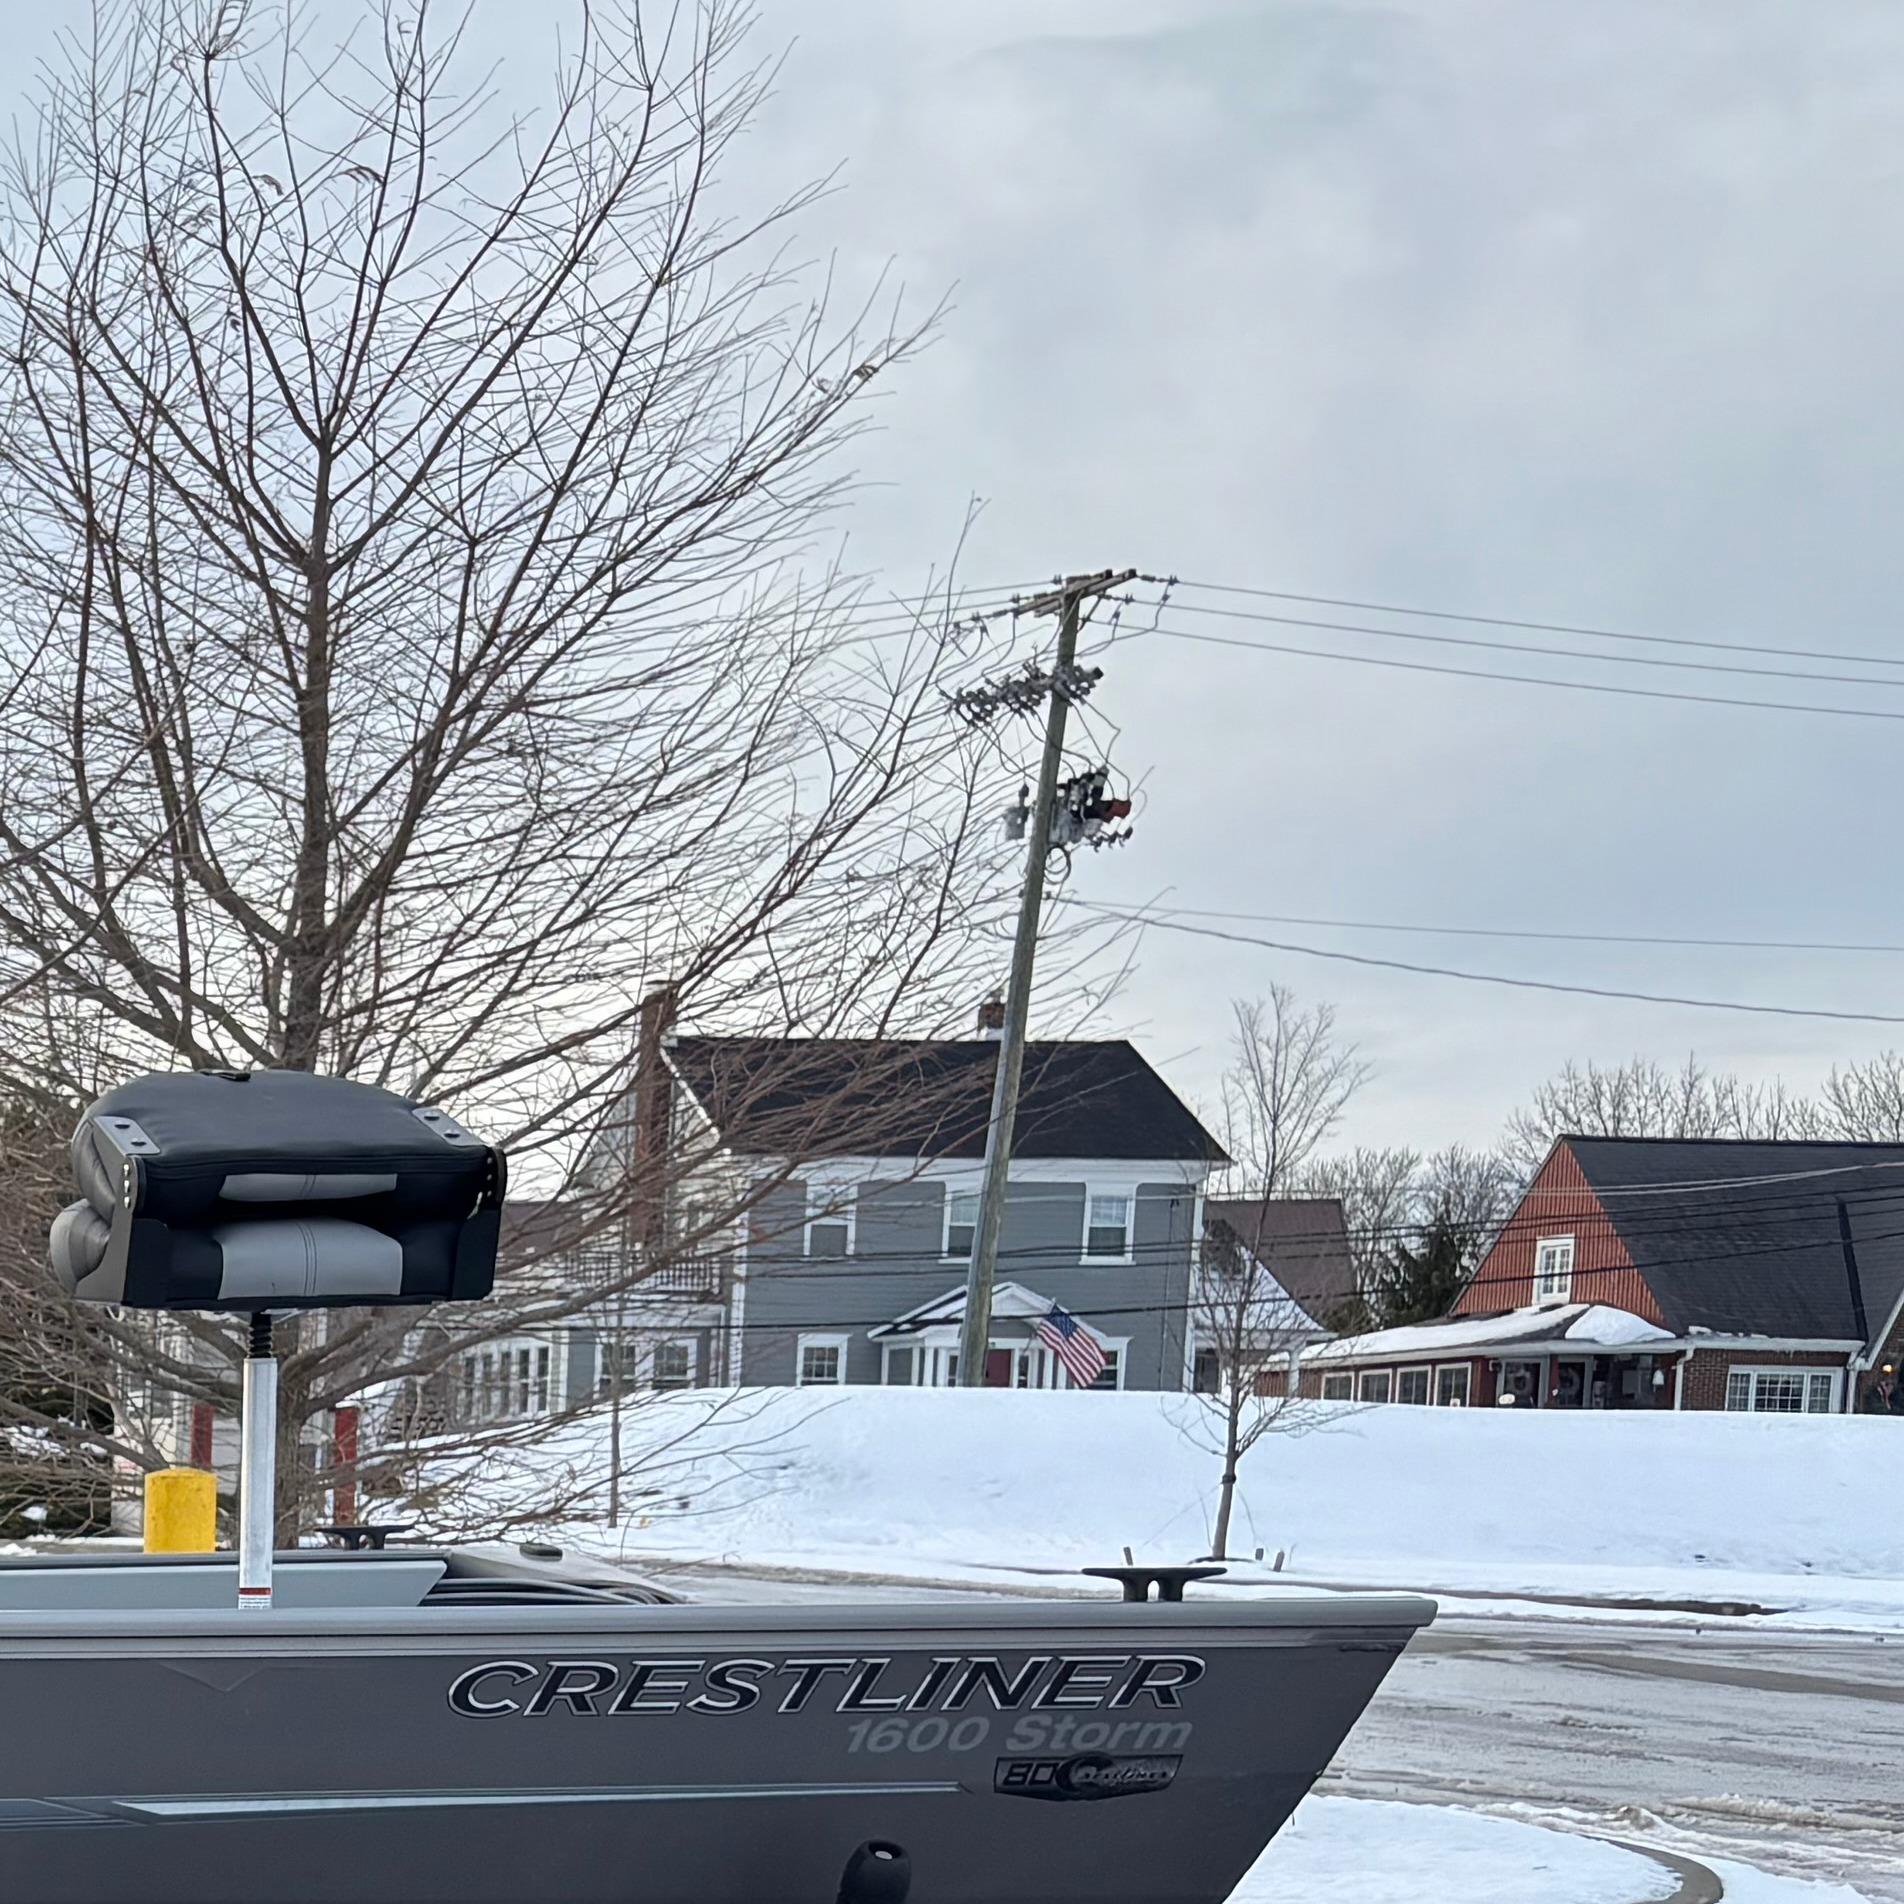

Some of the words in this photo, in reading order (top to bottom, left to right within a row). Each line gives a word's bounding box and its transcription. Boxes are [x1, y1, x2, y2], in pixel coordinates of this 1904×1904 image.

[446, 1654, 1206, 1718] CRESTLINER
[847, 1716, 990, 1753] 1600
[1005, 1714, 1193, 1751] Storm
